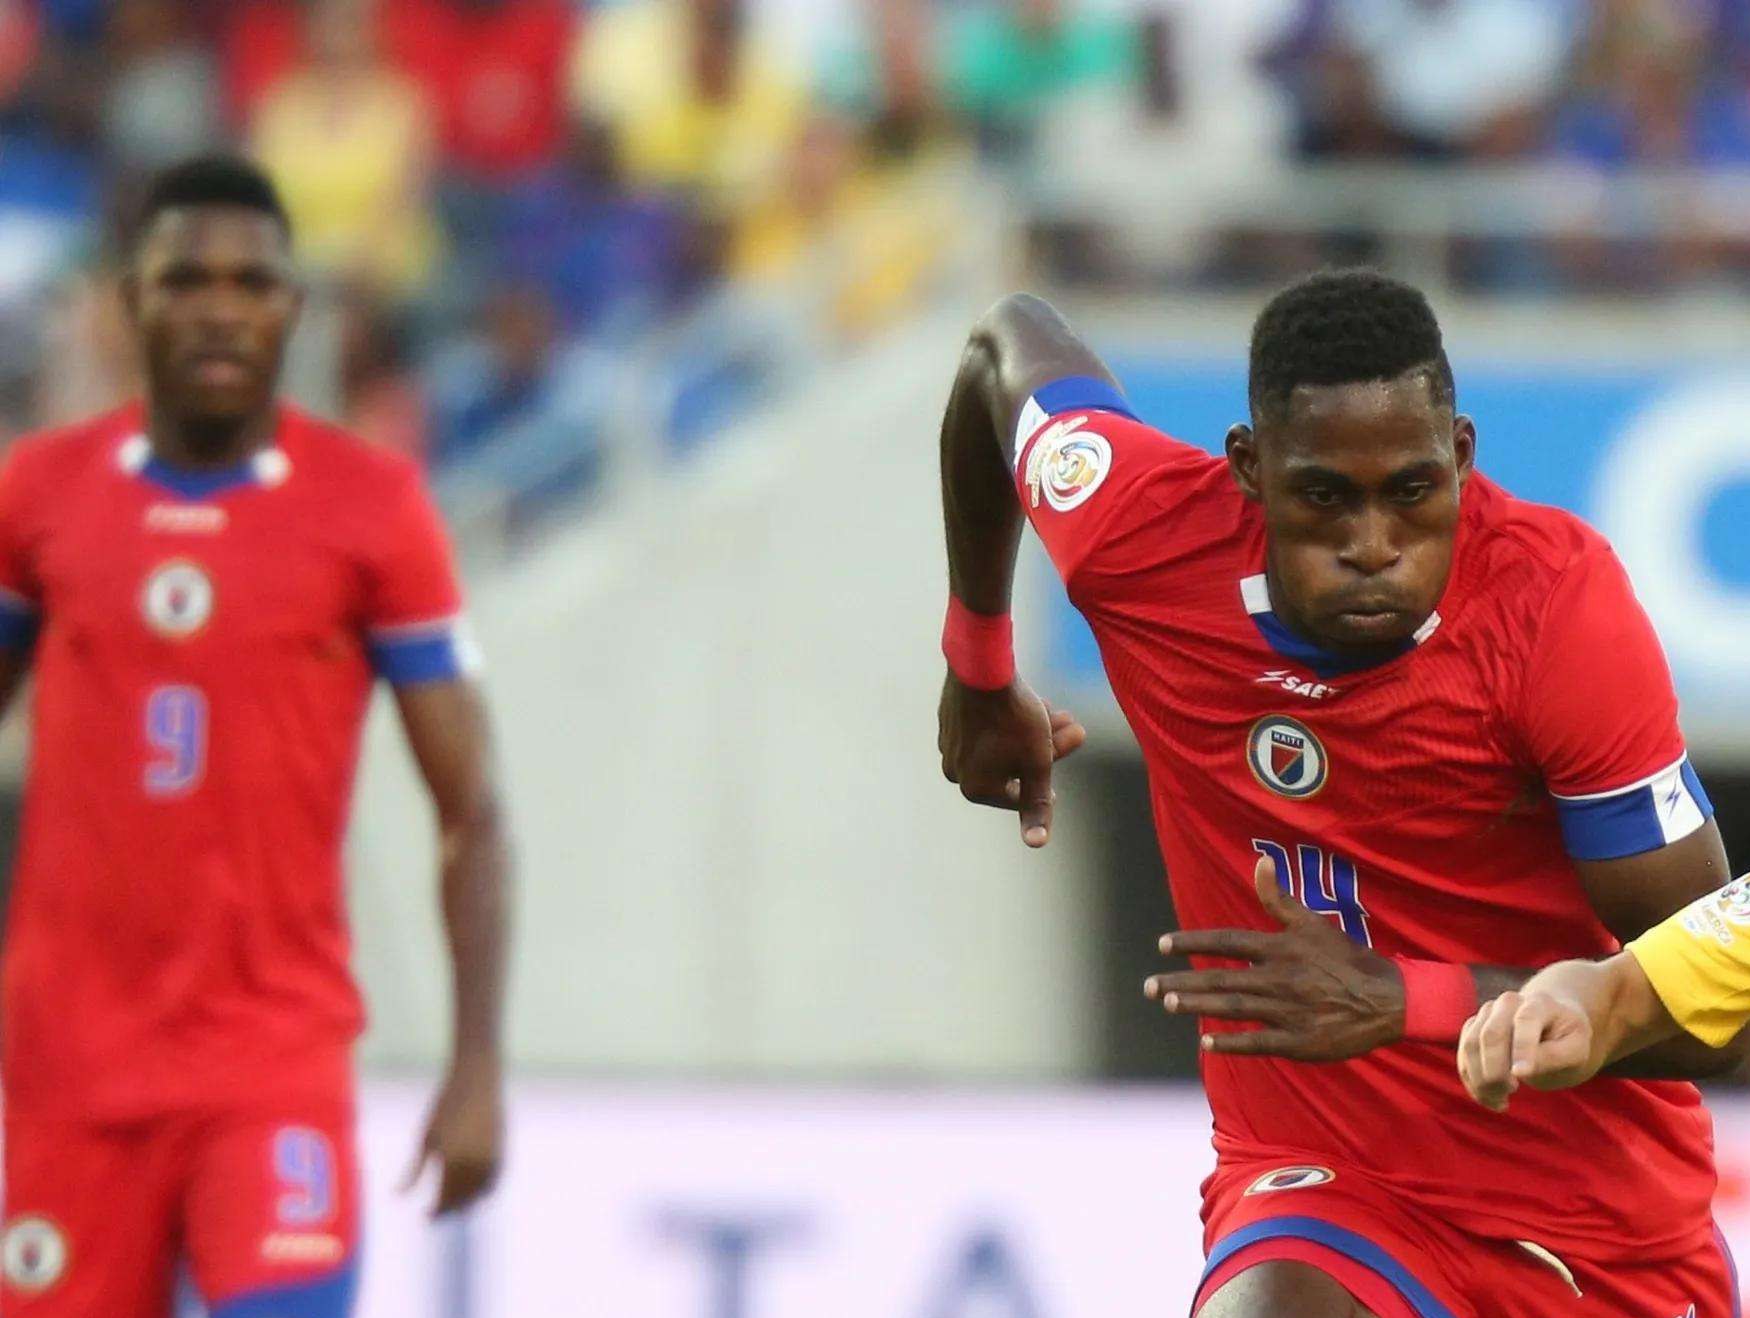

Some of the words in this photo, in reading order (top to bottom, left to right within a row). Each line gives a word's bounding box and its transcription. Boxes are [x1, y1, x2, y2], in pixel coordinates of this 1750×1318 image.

[141, 684, 209, 799] 9
[1273, 732, 1302, 747] HAITI
[272, 1124, 339, 1226] 9
